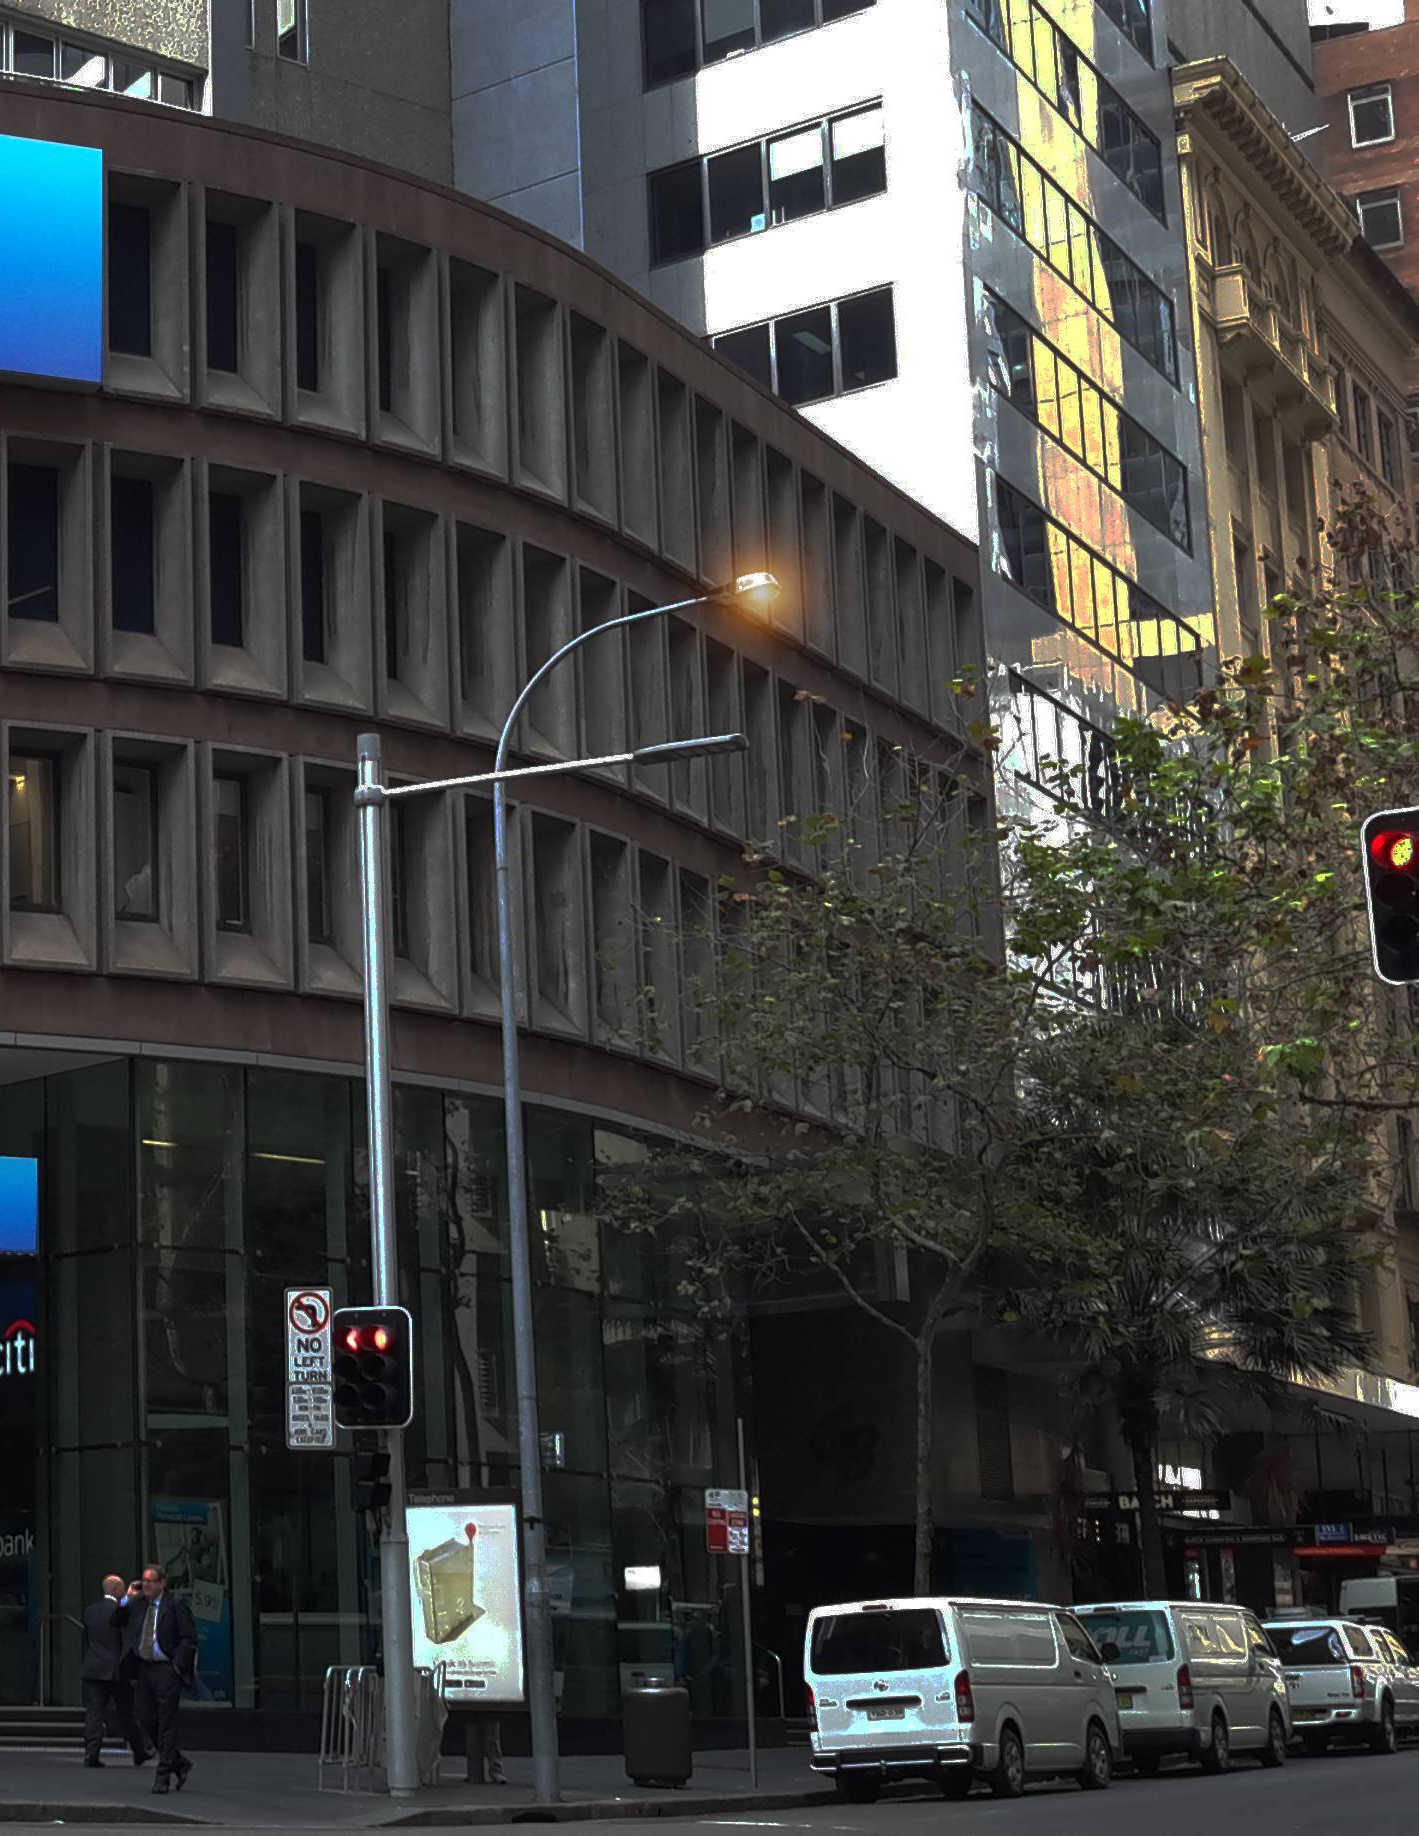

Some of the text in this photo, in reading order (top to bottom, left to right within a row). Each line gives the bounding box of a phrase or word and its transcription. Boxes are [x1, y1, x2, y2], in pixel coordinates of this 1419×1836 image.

[296, 1337, 322, 1354] NO
[293, 1356, 326, 1368] LEFT
[293, 1370, 328, 1382] TURN
